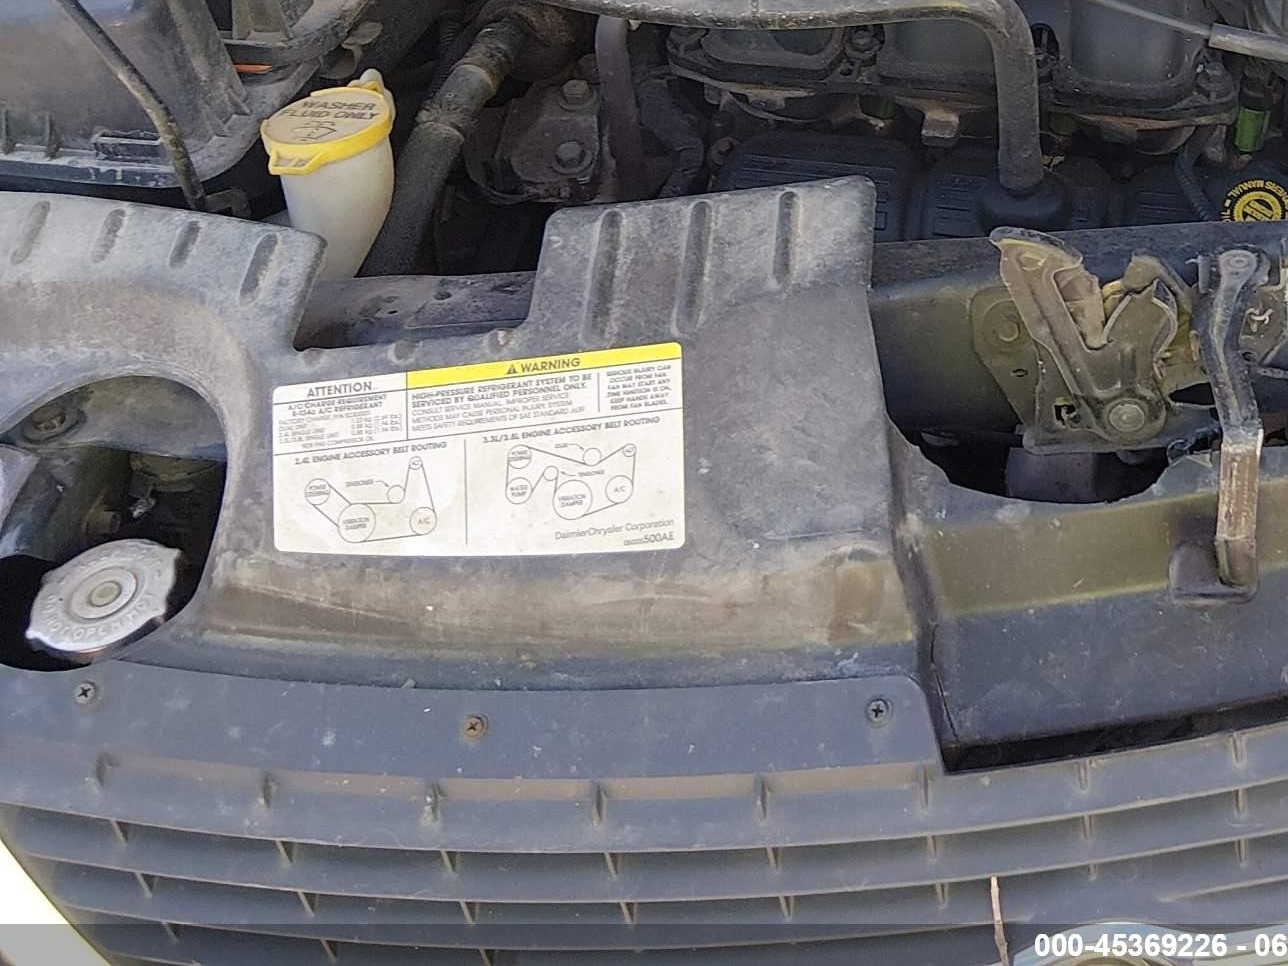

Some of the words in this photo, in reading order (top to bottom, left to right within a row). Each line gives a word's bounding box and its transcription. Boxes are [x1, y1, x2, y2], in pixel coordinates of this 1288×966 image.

[302, 101, 376, 110] WASHER
[282, 109, 329, 117] FLUID
[334, 111, 381, 120] ONLY
[1227, 180, 1265, 197] MANUAL
[520, 357, 582, 373] WARNING
[307, 381, 372, 397] ATTENTION
[412, 386, 474, 400] HIGH-PRESSURE
[478, 383, 532, 393] REFRIGERANT
[536, 376, 565, 385] SYSTEM
[583, 372, 592, 380] BE
[305, 399, 335, 408] CHARGE
[412, 397, 451, 408] SERVICED
[455, 395, 464, 403] BY
[467, 392, 510, 402] QUALIFIED
[513, 384, 560, 396] PERSONNEL
[334, 401, 382, 411] REFRIGERANT
[522, 428, 550, 439] ENGINE
[554, 422, 601, 435] ACCESSORY
[605, 420, 621, 429] BELT
[624, 415, 660, 427] ROUTING
[312, 452, 341, 463] ENGINE
[343, 447, 390, 459] ACCESSORY
[393, 445, 409, 454] BELT
[412, 441, 447, 452] ROUTING
[555, 524, 623, 540] DaimlerChrysler
[625, 519, 675, 533] Corporation
[72, 621, 122, 638] OPEN
